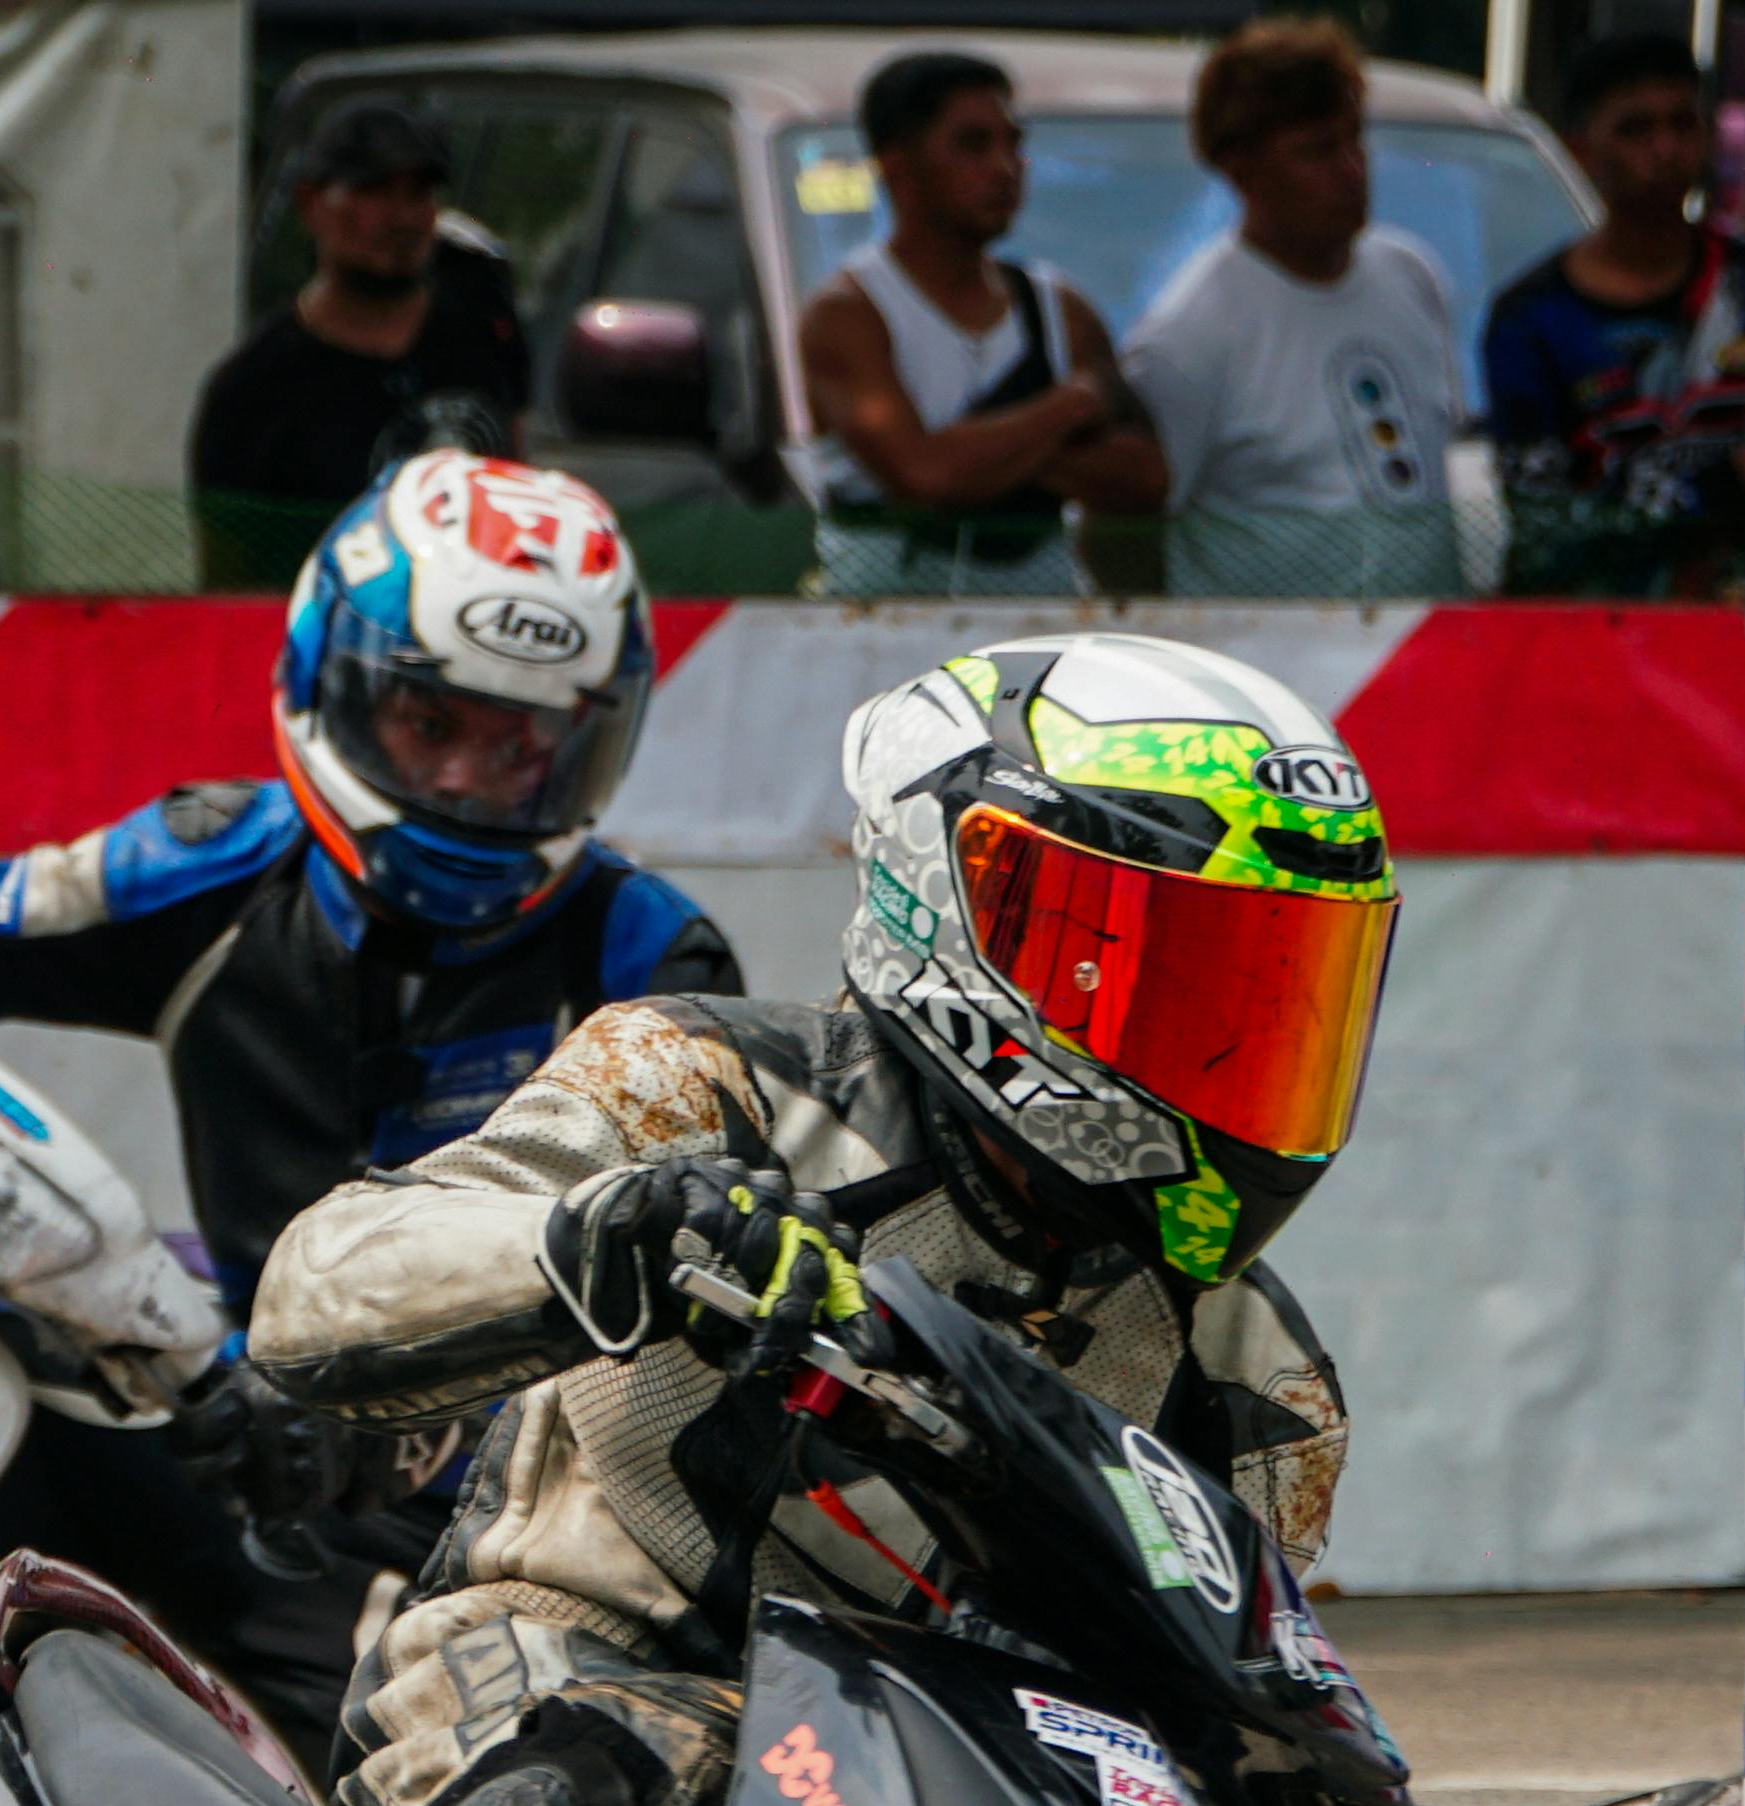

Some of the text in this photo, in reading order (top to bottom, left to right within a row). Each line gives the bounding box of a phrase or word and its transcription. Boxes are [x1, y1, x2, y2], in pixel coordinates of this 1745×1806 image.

[472, 602, 571, 646] Arai
[1257, 757, 1362, 799] KYT
[900, 958, 1082, 1106] KYT
